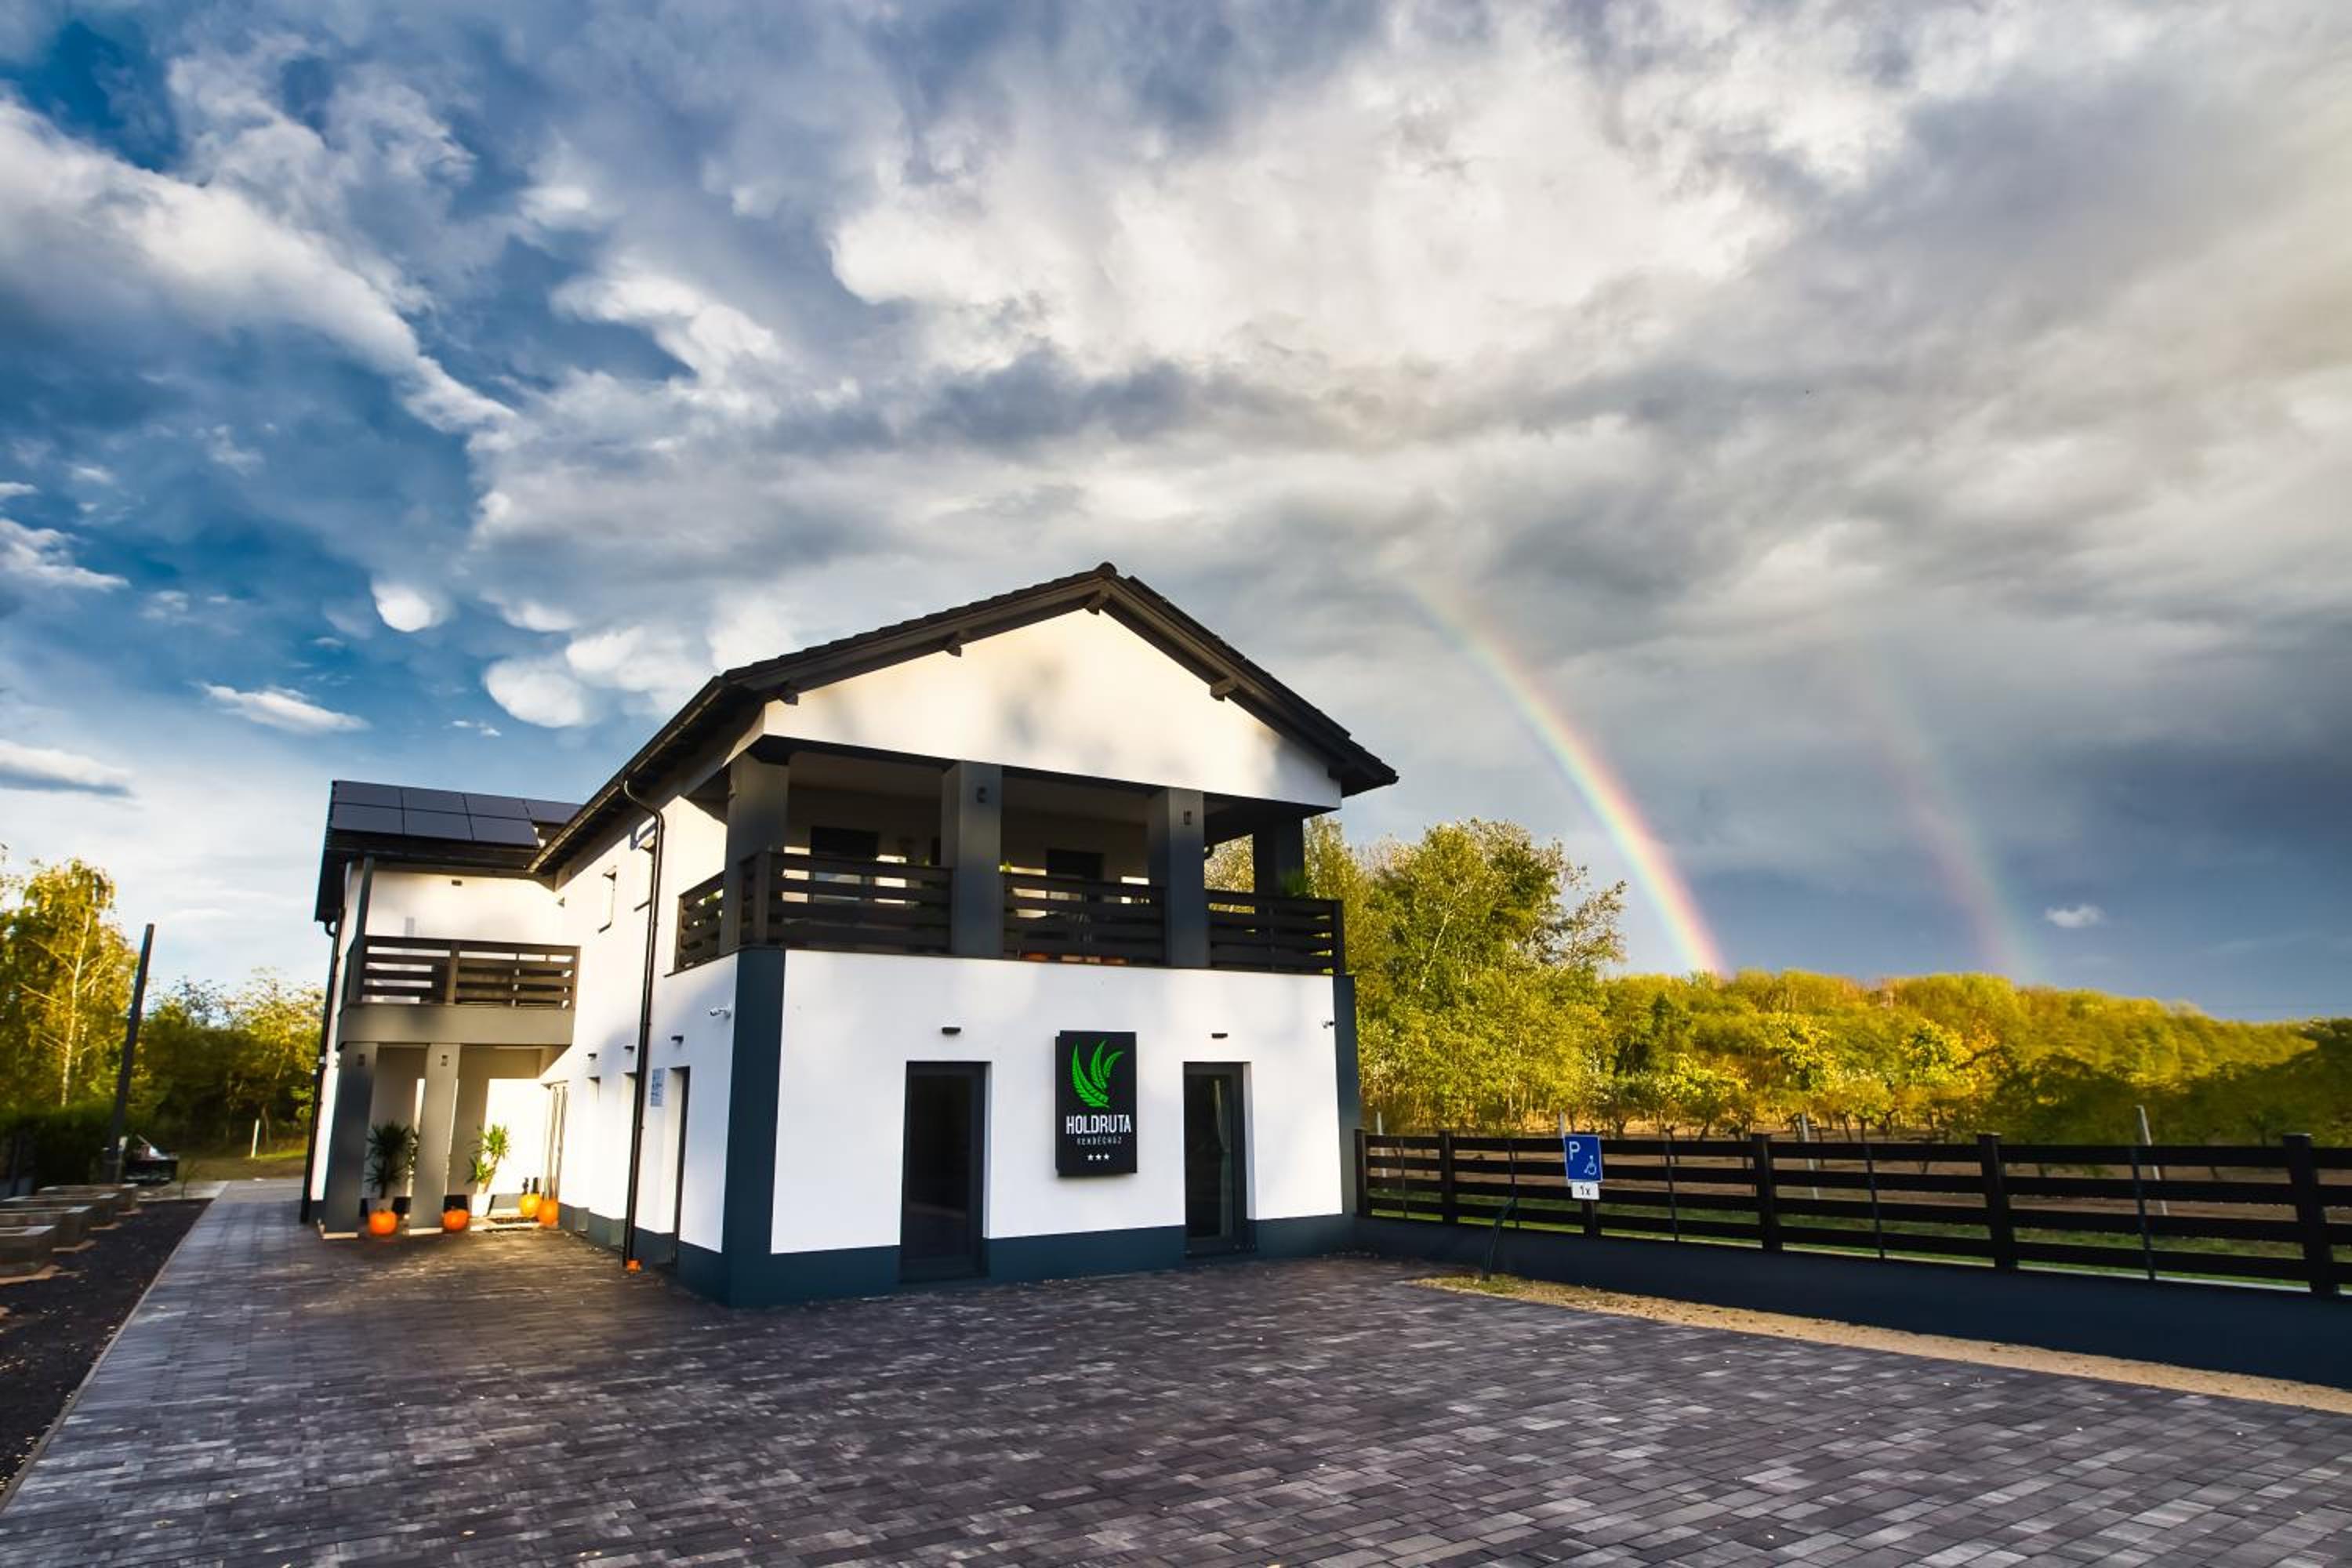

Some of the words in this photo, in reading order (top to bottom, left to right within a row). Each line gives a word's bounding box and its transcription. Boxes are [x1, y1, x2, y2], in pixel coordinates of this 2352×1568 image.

[1066, 1115, 1131, 1134] HOLDRUTA
[1570, 1142, 1581, 1160] P
[1580, 1185, 1591, 1196] 1x
